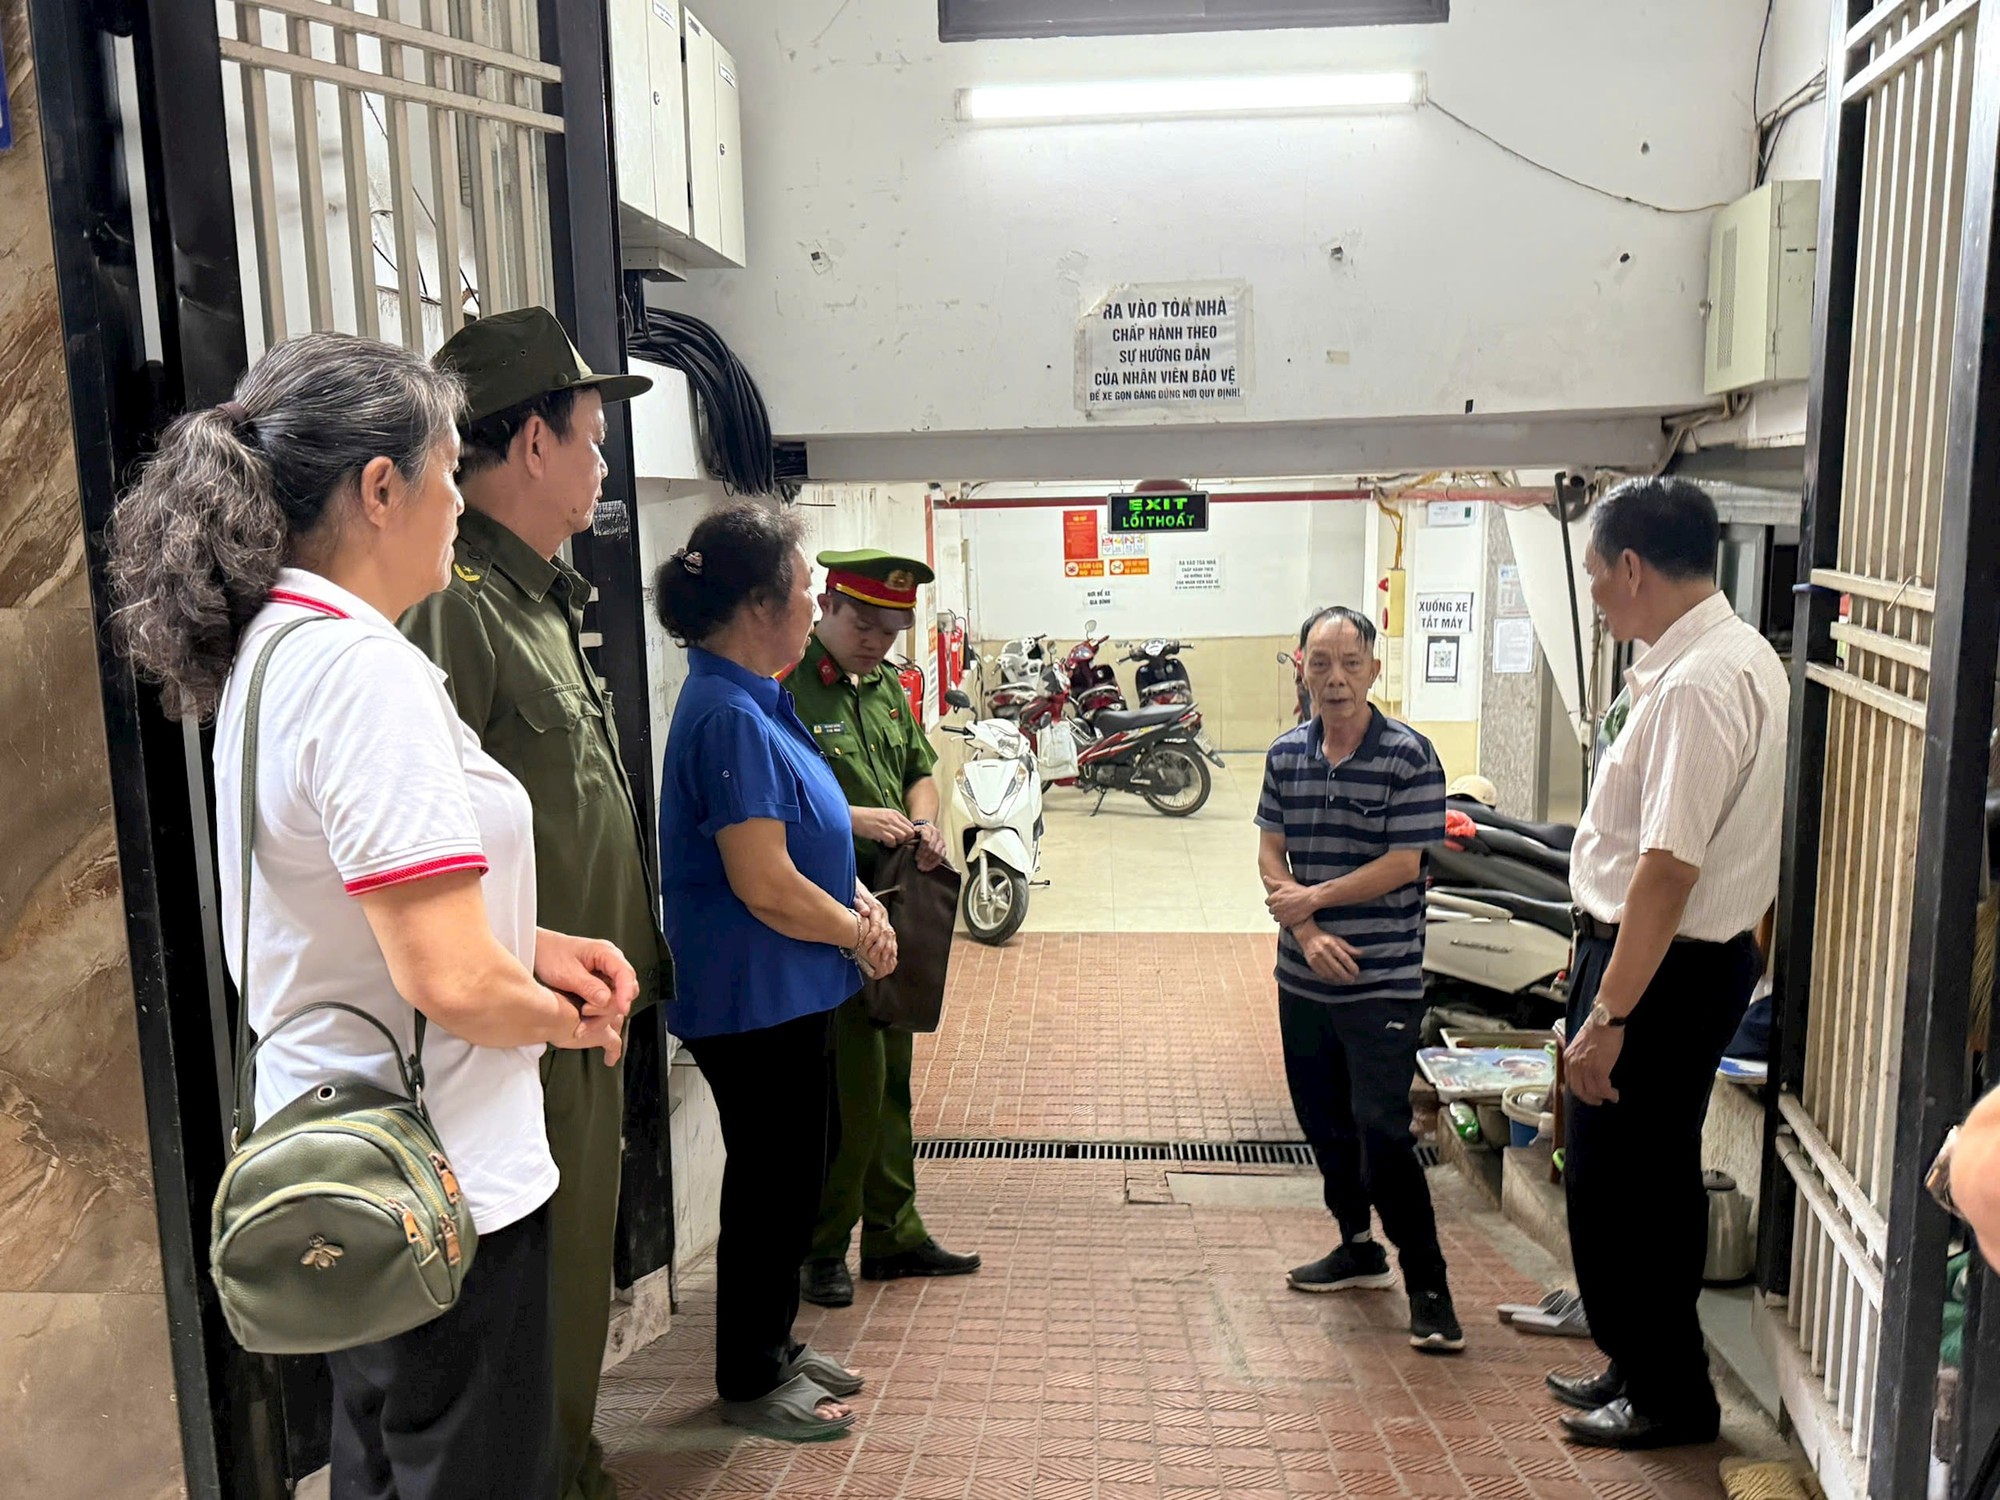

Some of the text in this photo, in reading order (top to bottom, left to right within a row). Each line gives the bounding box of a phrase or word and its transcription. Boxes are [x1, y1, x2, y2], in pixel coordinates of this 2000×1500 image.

[1103, 303, 1123, 320] RA
[1128, 298, 1157, 319] VÀO
[1195, 296, 1227, 316] NHÀ
[1112, 322, 1217, 342] CHẤP HÀNH THEO
[1119, 342, 1211, 366] SỰ HƯỚNG DẪN
[1094, 363, 1236, 386] CỦA NHÂN VIÊN BẢO VỆ
[1102, 390, 1113, 401] XE
[1114, 390, 1132, 403] GỌN
[1133, 388, 1157, 401] GÀNG
[1183, 388, 1197, 399] NƠI
[1199, 388, 1216, 399] QUY
[1217, 387, 1240, 400] ĐỊNH!
[1129, 498, 1188, 511] EXIT
[1122, 511, 1195, 528] LỐI THOÁT
[1418, 597, 1468, 612] XUỐNG XE
[1441, 615, 1463, 629] MÁY
